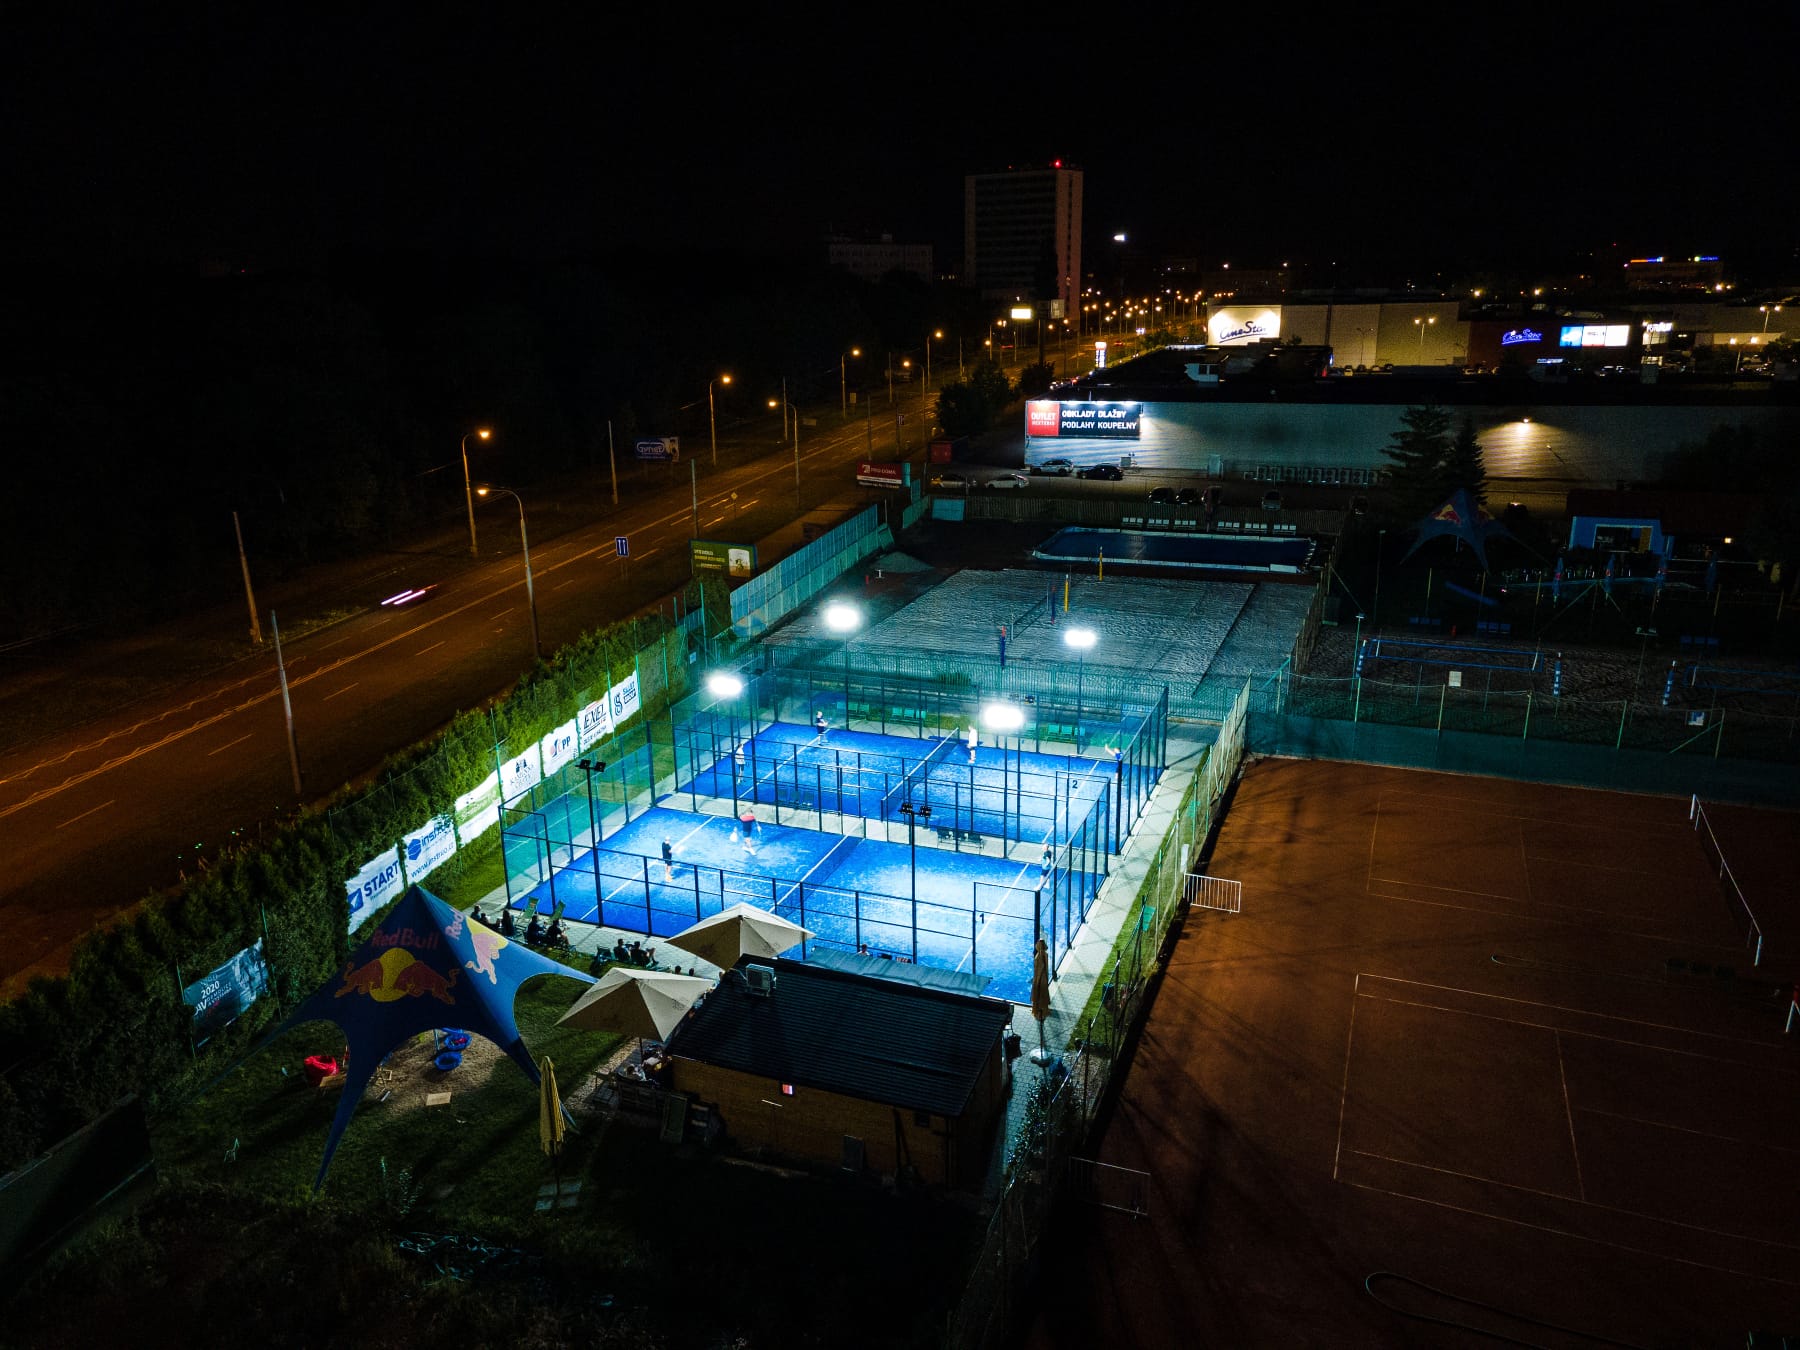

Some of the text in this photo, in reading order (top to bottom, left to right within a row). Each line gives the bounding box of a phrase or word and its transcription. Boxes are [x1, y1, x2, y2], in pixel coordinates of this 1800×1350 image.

[1031, 411, 1056, 421] OUTLET
[1061, 408, 1127, 418] OBKLADY DLAŽBY
[1061, 421, 1095, 429] PODLAHY
[1097, 422, 1137, 430] KOUPELNY
[1071, 779, 1078, 789] 2
[363, 860, 399, 897] START
[979, 912, 985, 924] 1
[371, 927, 441, 950] Red Bull
[201, 980, 220, 999] 2020
